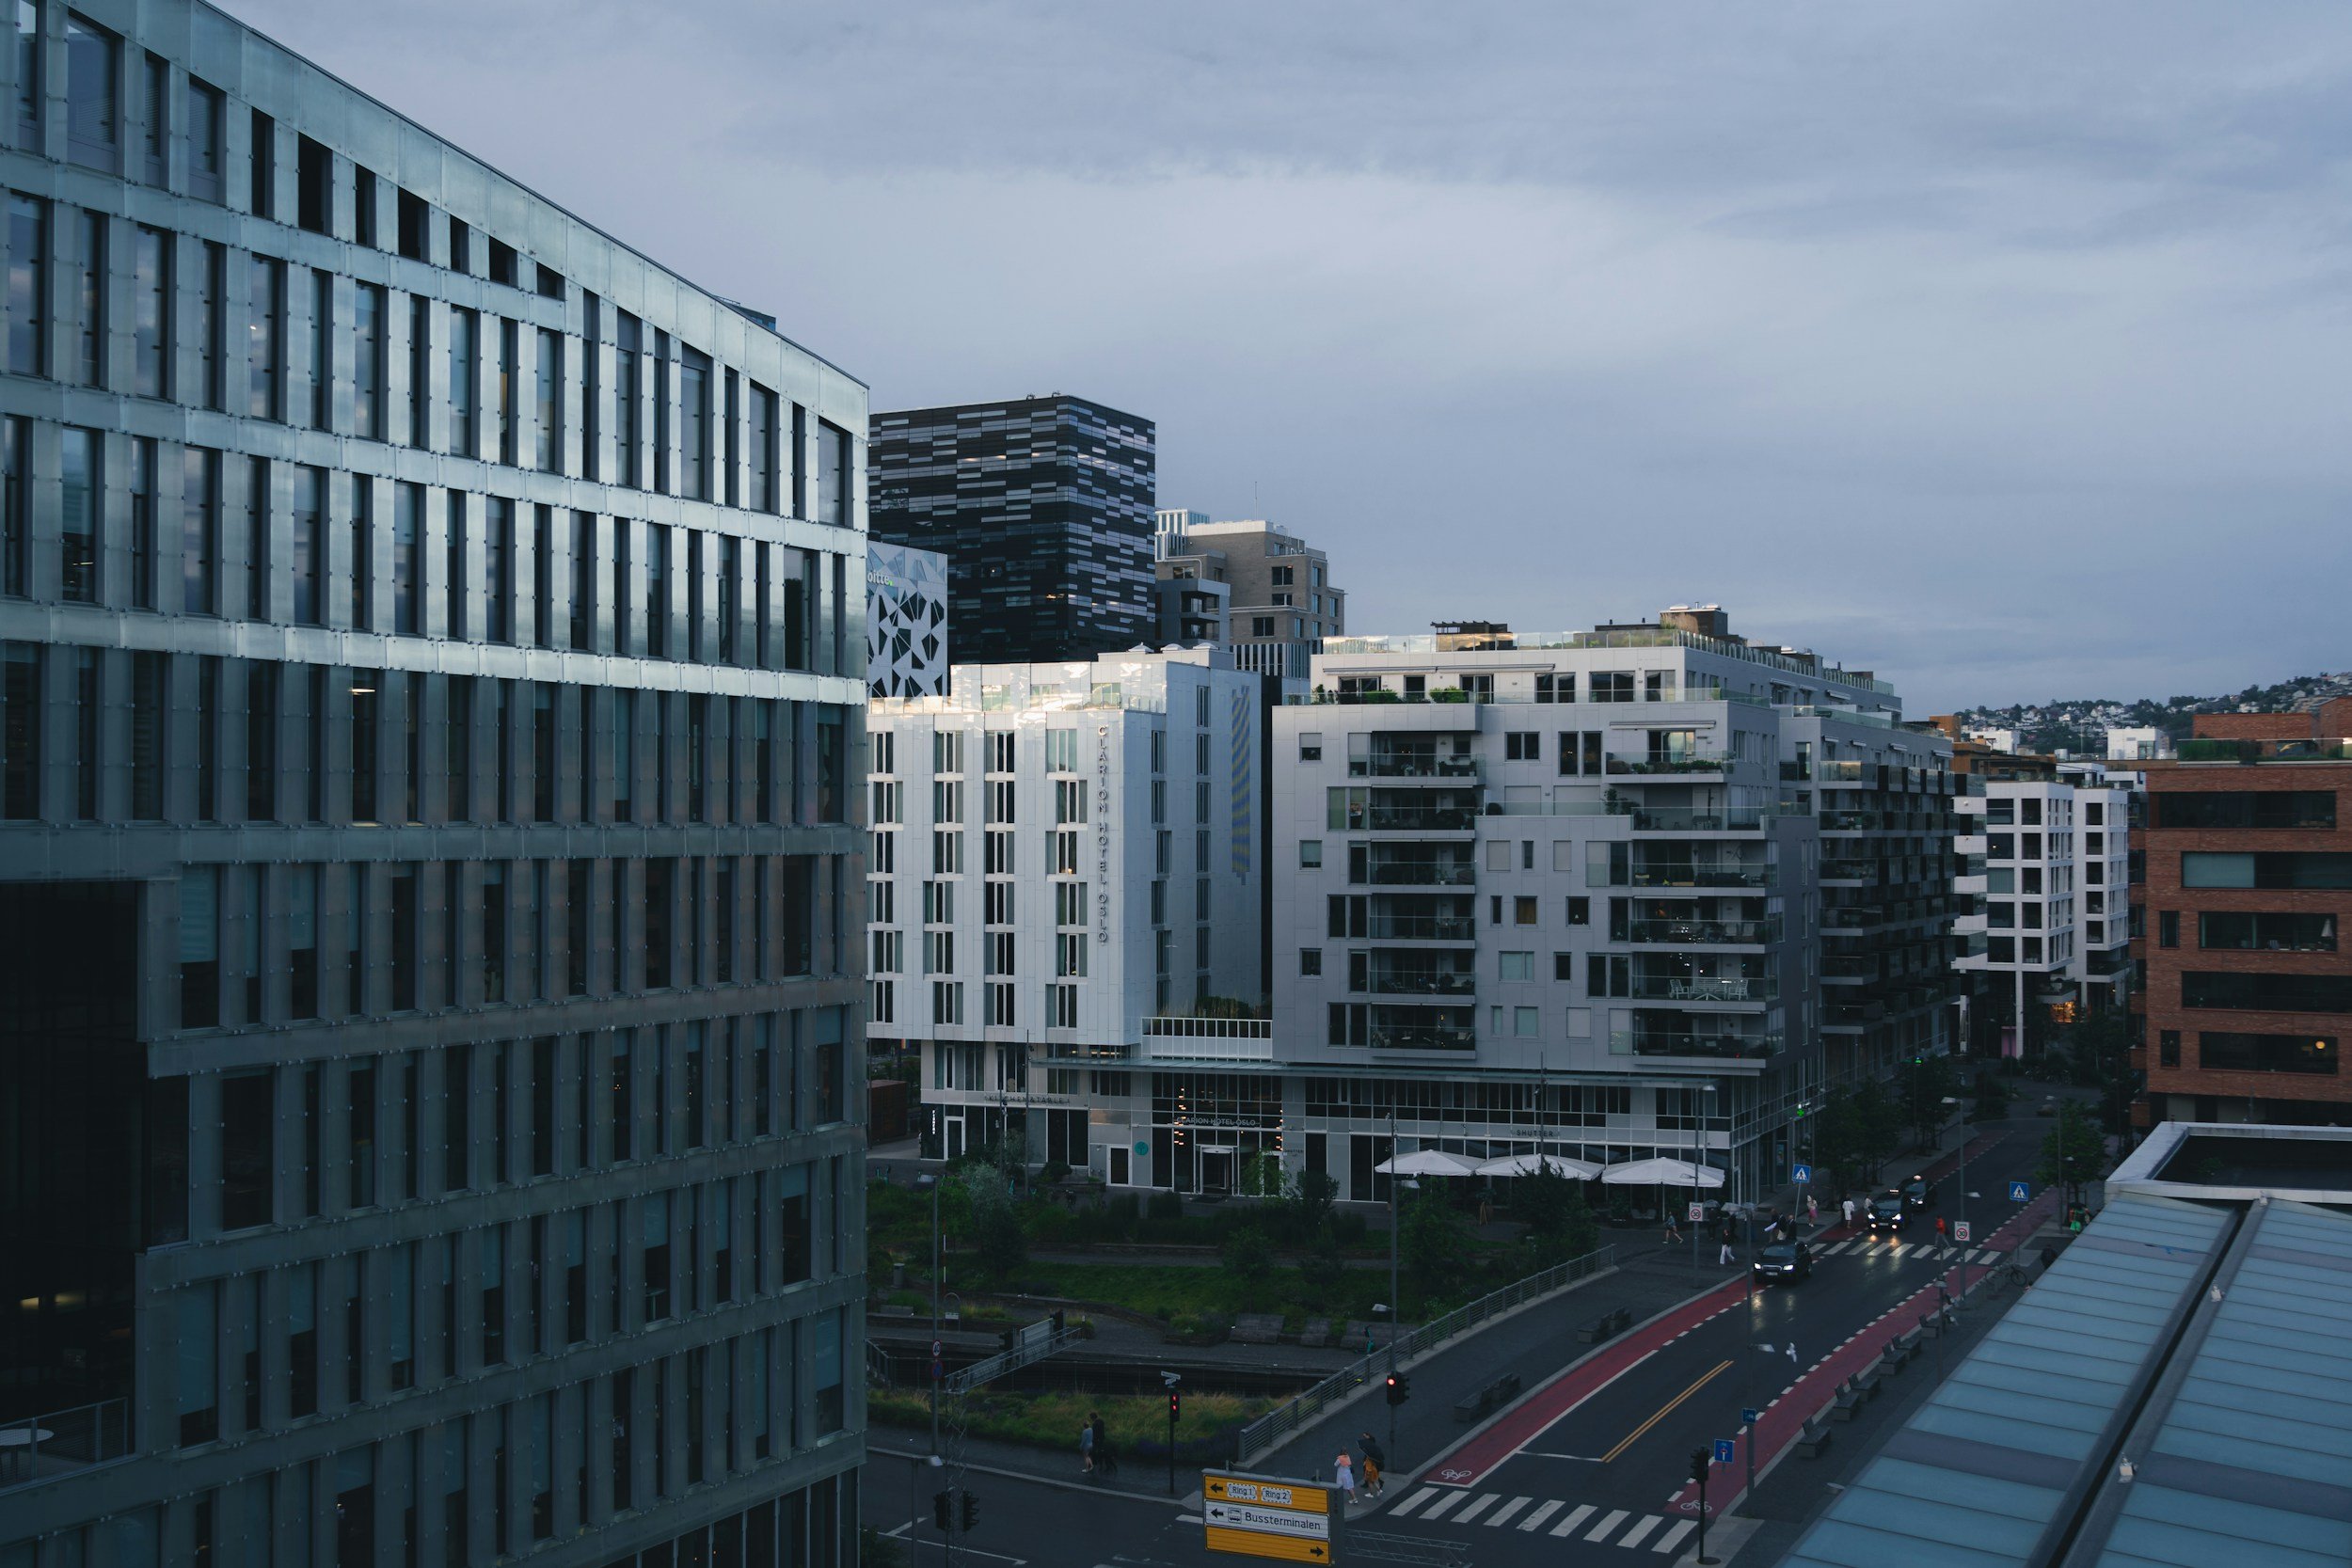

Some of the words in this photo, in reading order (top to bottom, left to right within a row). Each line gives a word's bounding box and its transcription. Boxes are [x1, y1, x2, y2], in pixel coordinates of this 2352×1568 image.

[1098, 725, 1108, 813] CLARION
[1098, 823, 1108, 884] HOTEL
[1098, 894, 1108, 942] OSLO
[1211, 1117, 1234, 1126] HOTEL
[1232, 1486, 1248, 1496] Ring
[1265, 1490, 1280, 1499] Ring
[1245, 1512, 1321, 1529] Bussterminalen
